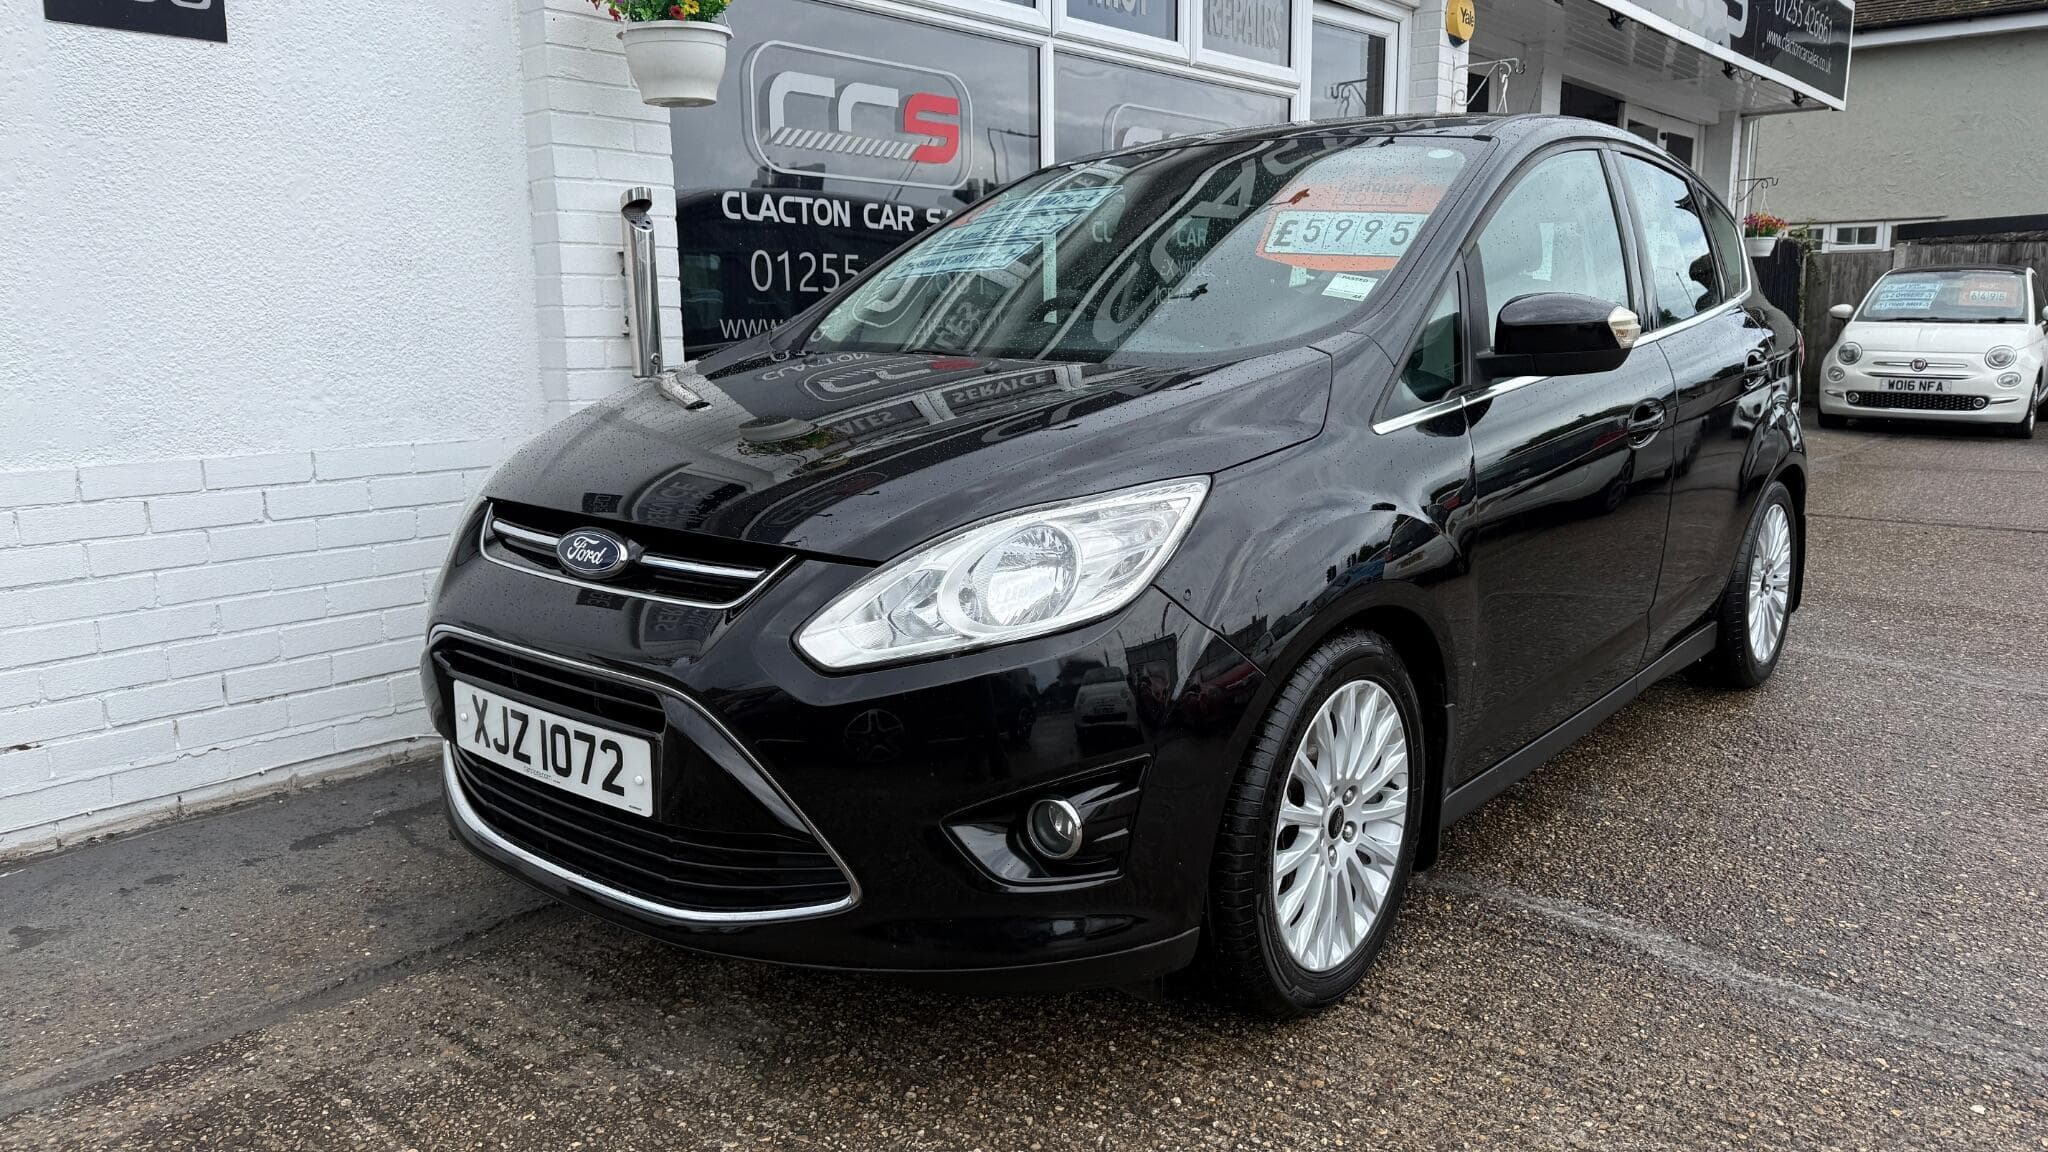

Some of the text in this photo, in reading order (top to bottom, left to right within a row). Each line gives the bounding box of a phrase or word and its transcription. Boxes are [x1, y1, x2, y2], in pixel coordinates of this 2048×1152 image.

[1460, 7, 1474, 27] Yale
[1805, 5, 1832, 45] 426661
[769, 71, 960, 164] CCS
[721, 190, 851, 228] CLACTON
[863, 202, 914, 231] CAR
[1273, 218, 1414, 246] £5995
[1888, 380, 1943, 391] WO16 NFA
[567, 536, 607, 565] Ford
